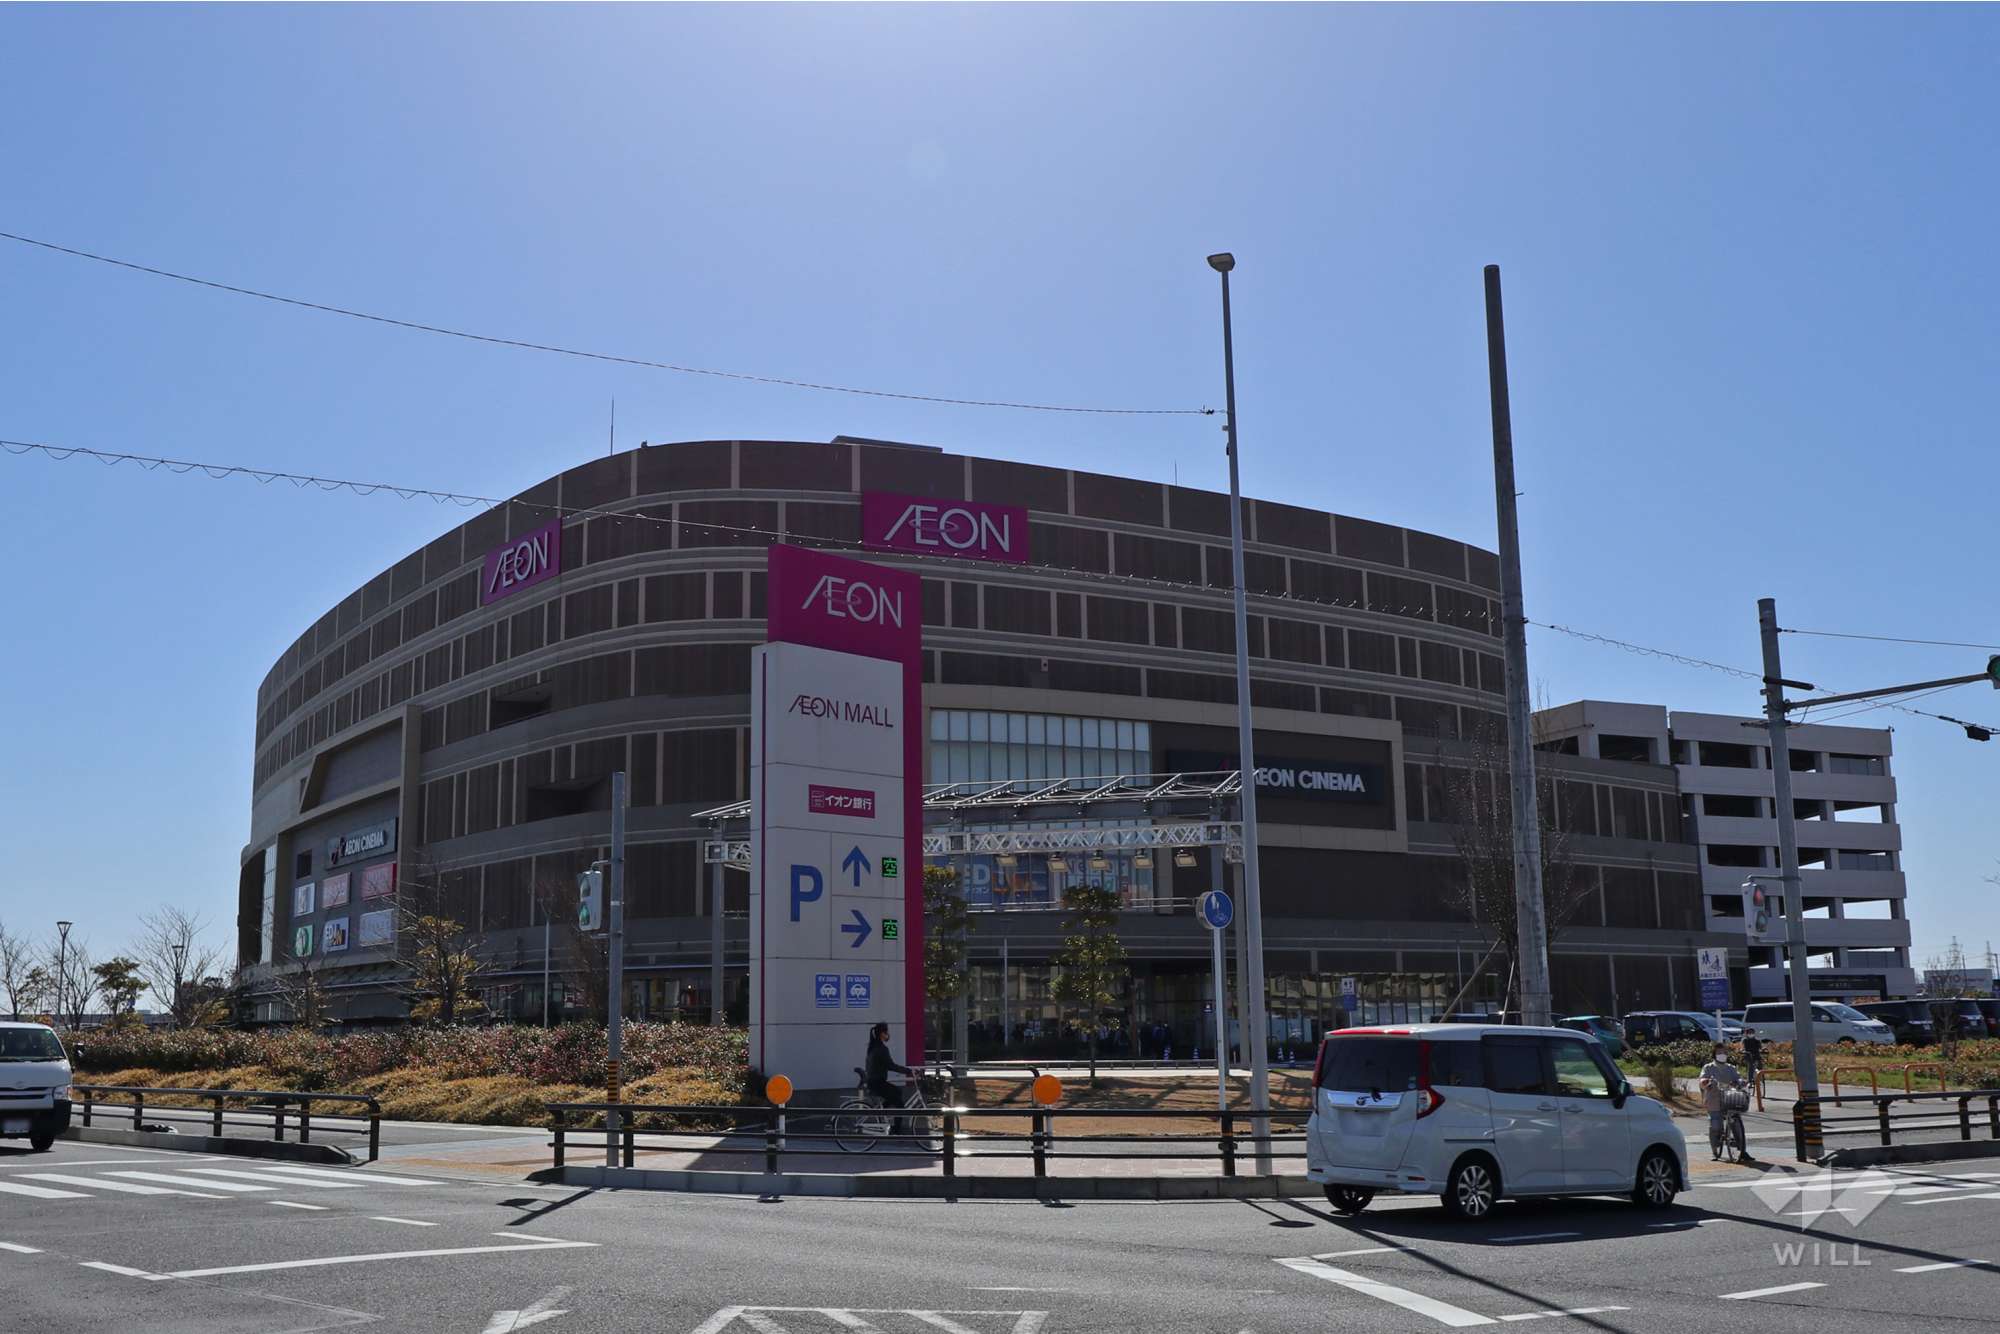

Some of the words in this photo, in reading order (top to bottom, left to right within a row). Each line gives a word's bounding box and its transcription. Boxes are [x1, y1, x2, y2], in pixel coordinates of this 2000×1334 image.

[844, 702, 894, 728] MALL
[1298, 770, 1366, 793] CINEMA
[825, 795, 873, 811] イオン銀行
[361, 831, 384, 851] CINEMA
[883, 857, 897, 878] 空
[790, 864, 824, 922] P
[883, 919, 897, 940] 空
